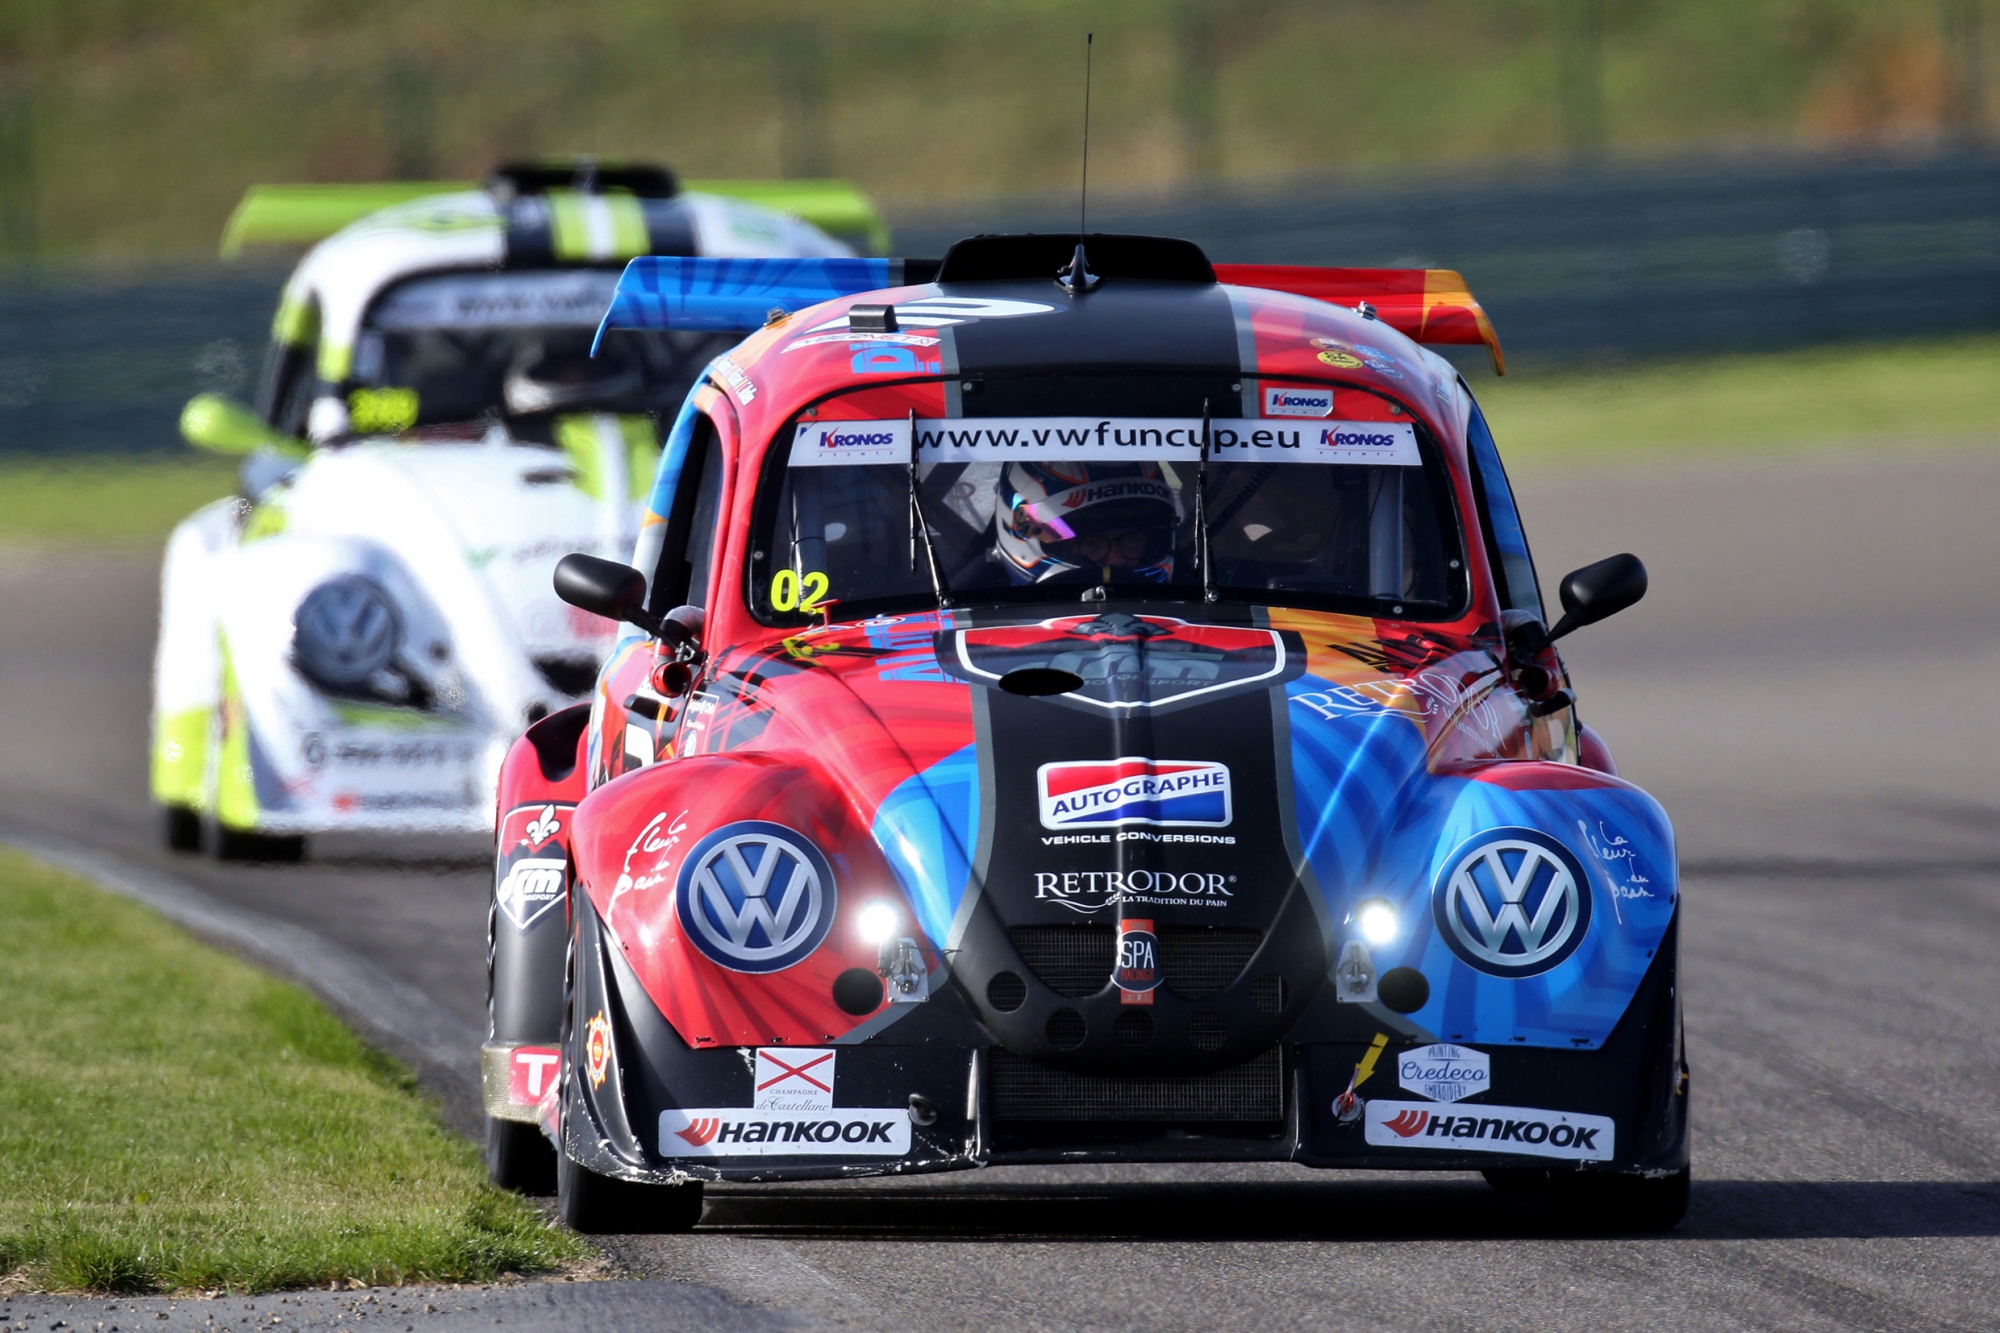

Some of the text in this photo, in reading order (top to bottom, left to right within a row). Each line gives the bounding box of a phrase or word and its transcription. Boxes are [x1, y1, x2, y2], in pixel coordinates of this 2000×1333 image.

[1272, 391, 1328, 407] KRONOS
[819, 427, 893, 448] KRONOS
[915, 421, 1301, 454] www.vwfuncup.eu
[1320, 425, 1394, 446] KRONOS
[770, 569, 829, 613] 02
[1052, 771, 1225, 816] AUTOGRAPHE
[1041, 831, 1236, 846] VEHICLE CONVERSIONS
[1122, 895, 1228, 907] LA TRADITION DU PAIN
[1121, 940, 1155, 969] SPA
[1428, 1046, 1460, 1059] PRINTING
[1401, 1060, 1488, 1081] Credeco
[770, 1088, 819, 1096] CHAMPAGNE
[1424, 1083, 1467, 1101] EMBROIDERY
